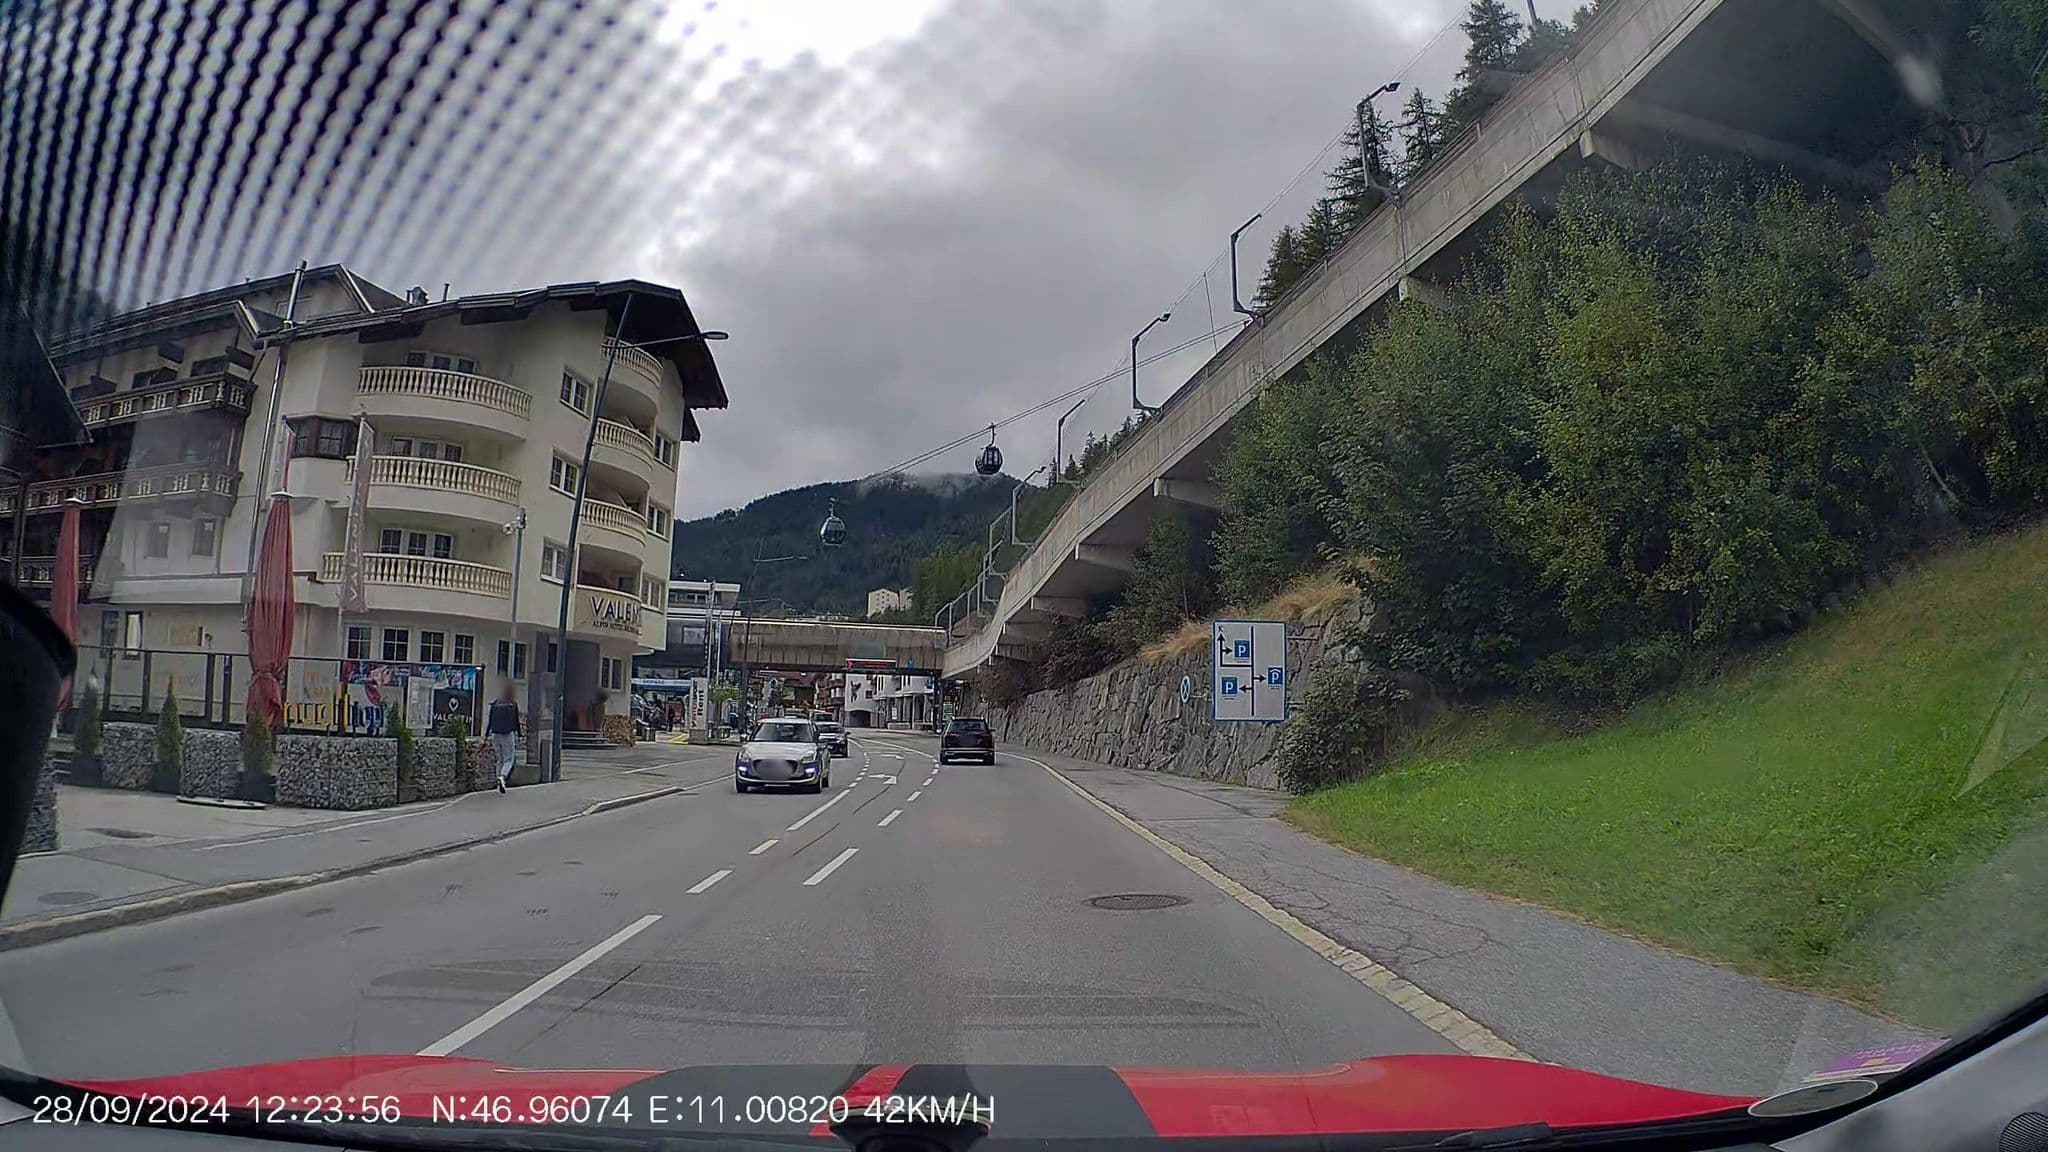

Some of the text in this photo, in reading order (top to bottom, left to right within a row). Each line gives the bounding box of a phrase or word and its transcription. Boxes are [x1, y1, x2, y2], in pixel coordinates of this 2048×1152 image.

[1238, 645, 1246, 657] P
[1271, 671, 1279, 684] P
[1225, 681, 1233, 694] P
